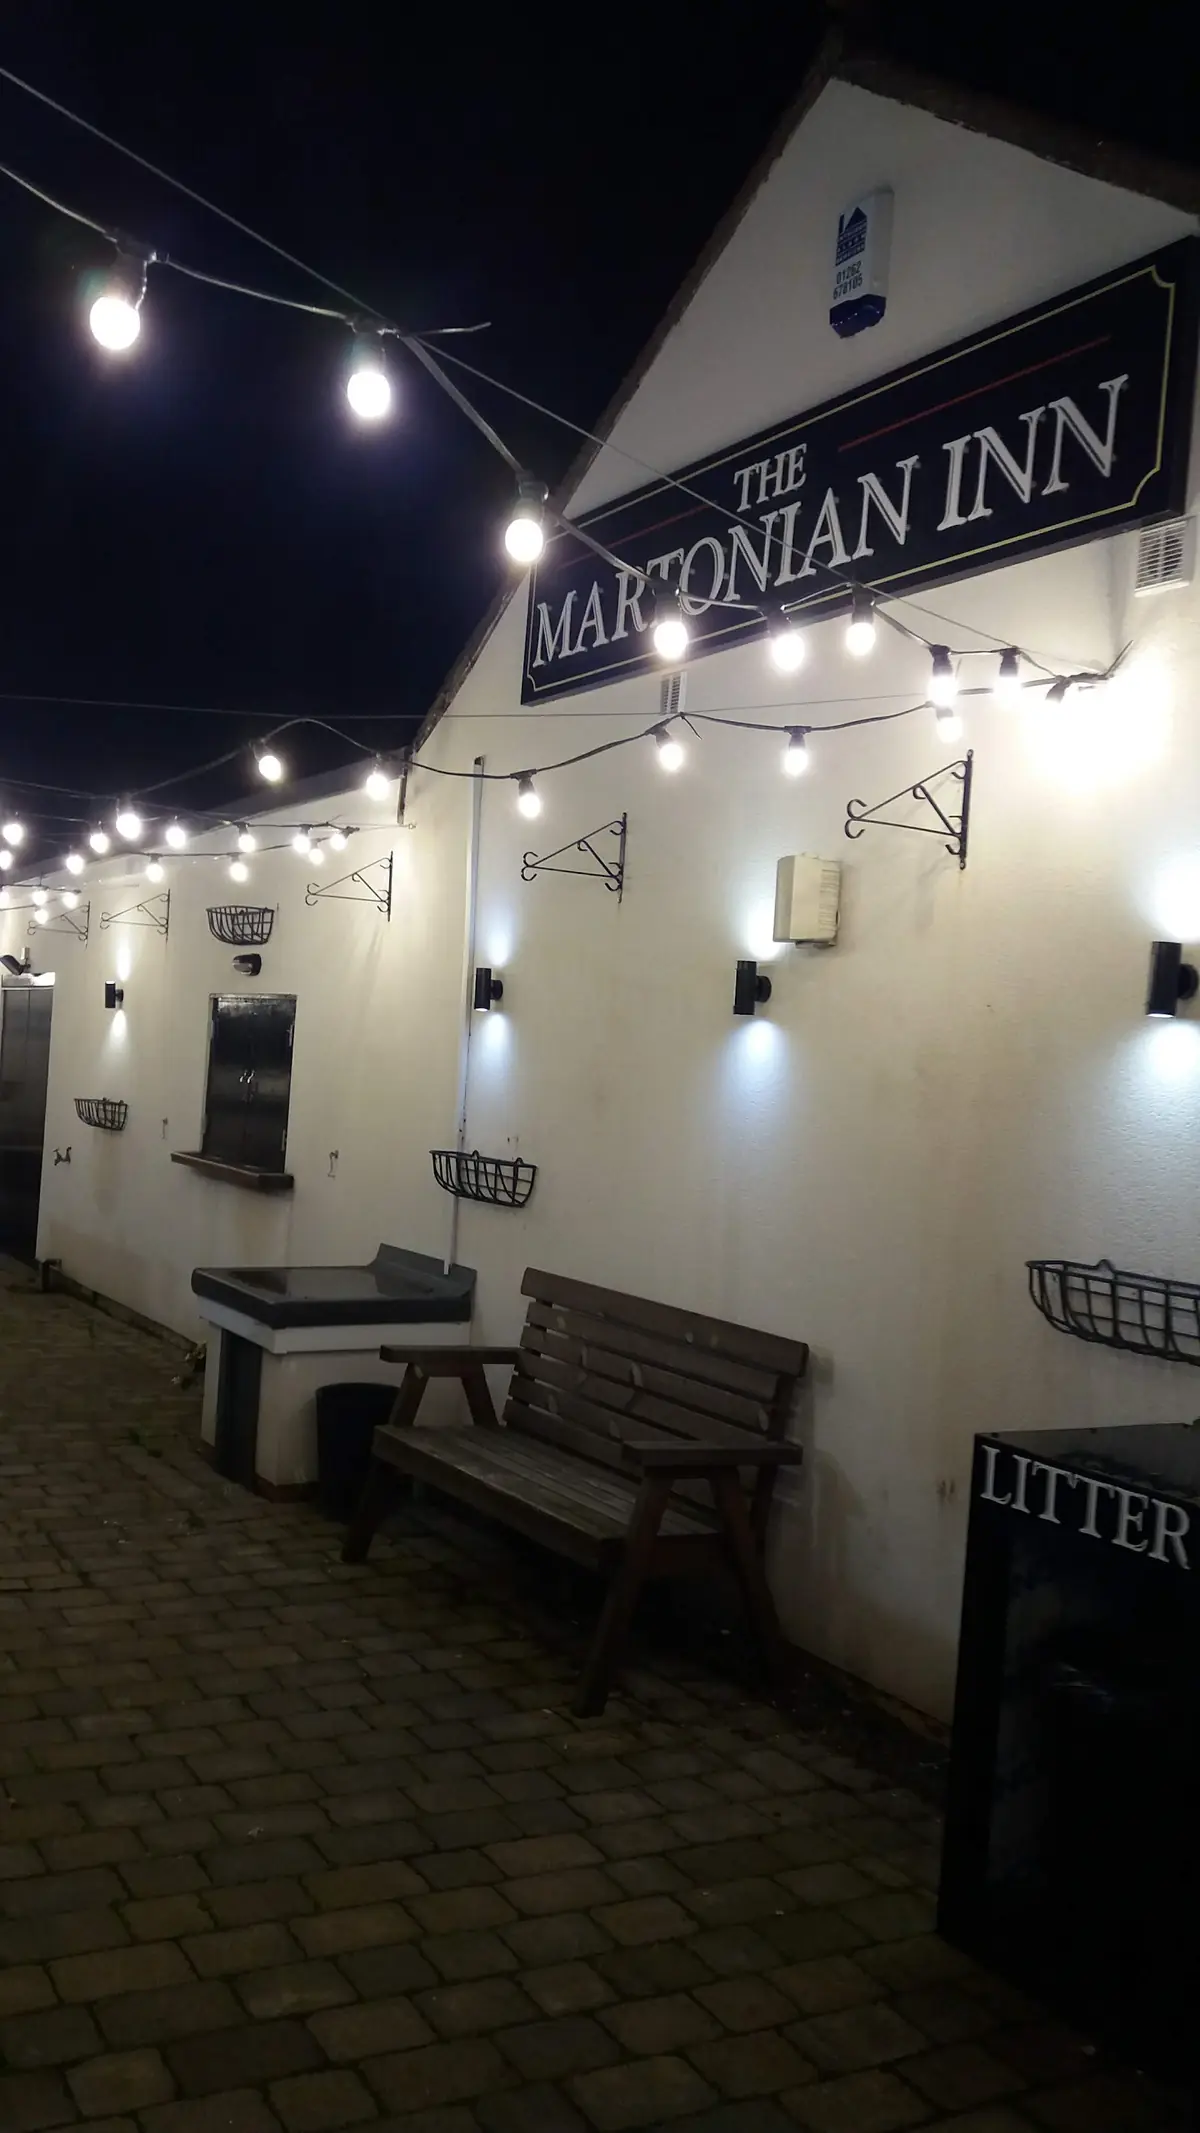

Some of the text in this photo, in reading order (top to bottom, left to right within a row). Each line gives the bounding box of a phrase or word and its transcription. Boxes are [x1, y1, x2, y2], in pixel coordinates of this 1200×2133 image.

[733, 443, 807, 512] THE
[937, 374, 1129, 531] INN
[980, 1445, 1191, 1570] LITTER
